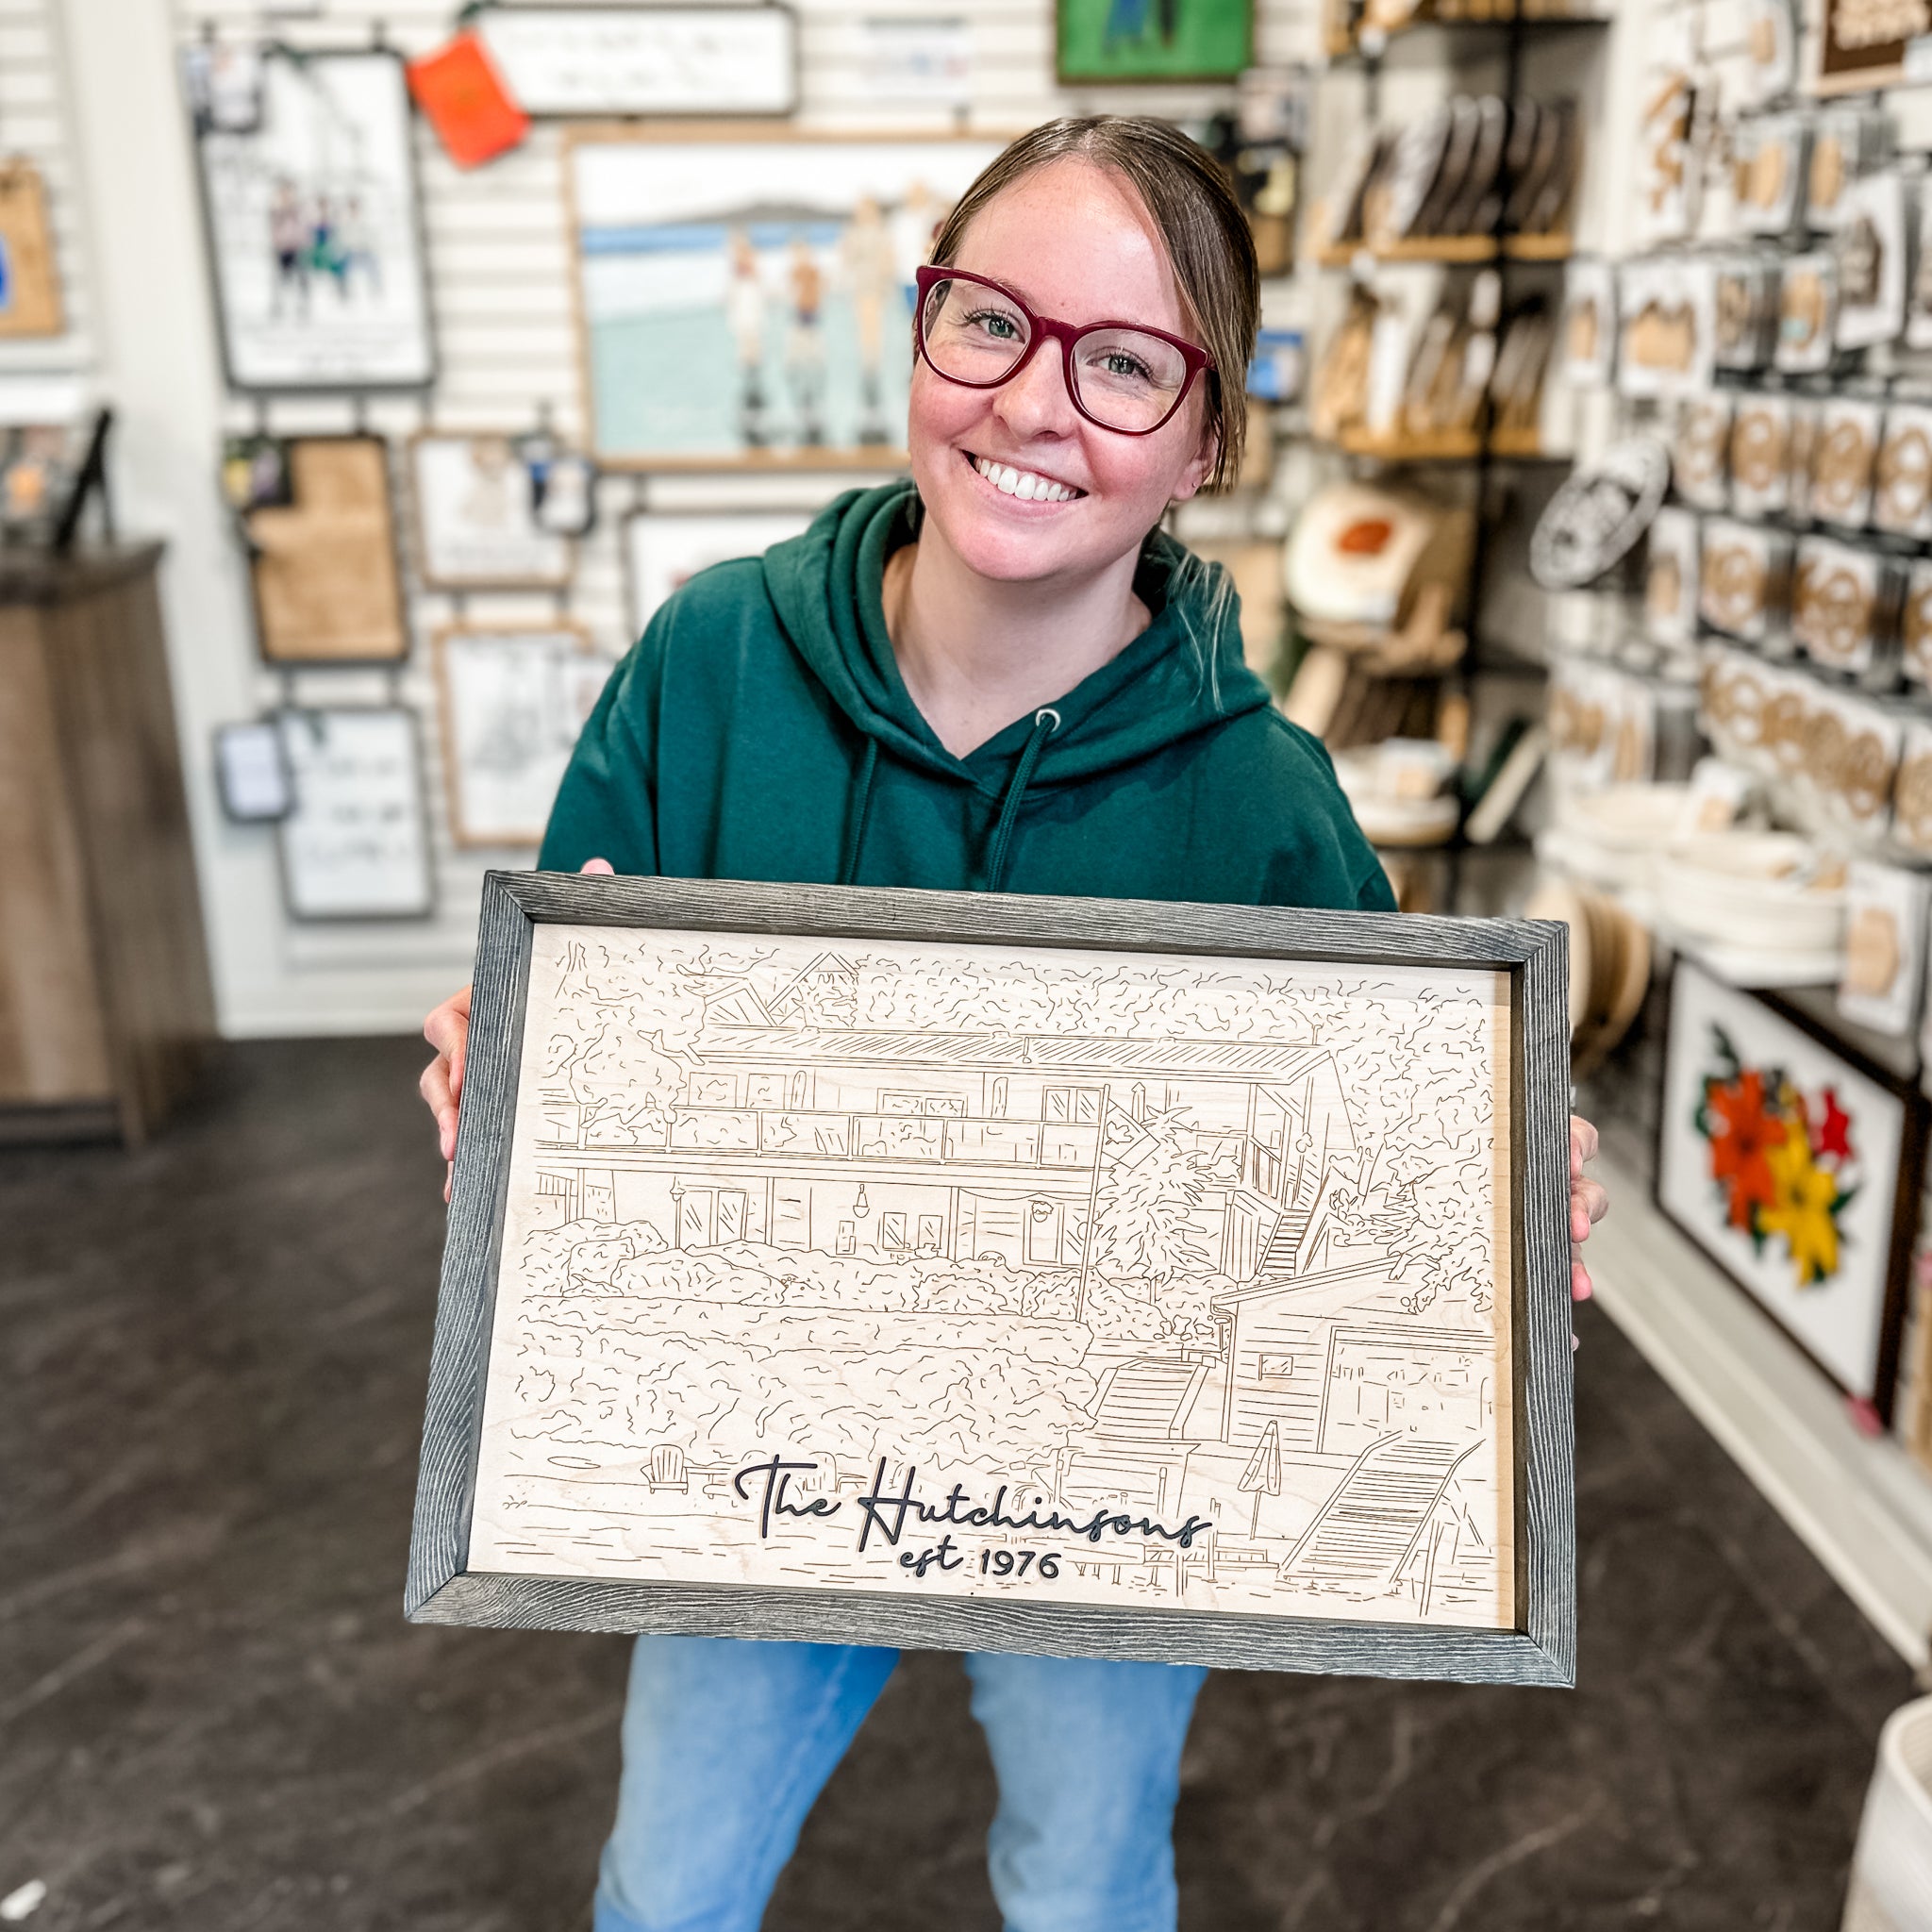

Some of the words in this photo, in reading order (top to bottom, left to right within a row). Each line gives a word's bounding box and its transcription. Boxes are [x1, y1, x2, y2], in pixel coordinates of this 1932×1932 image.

[734, 1454, 841, 1539] The
[858, 1456, 1213, 1552] Hutchinsons
[899, 1534, 964, 1578] est
[981, 1549, 1062, 1579] 1976
